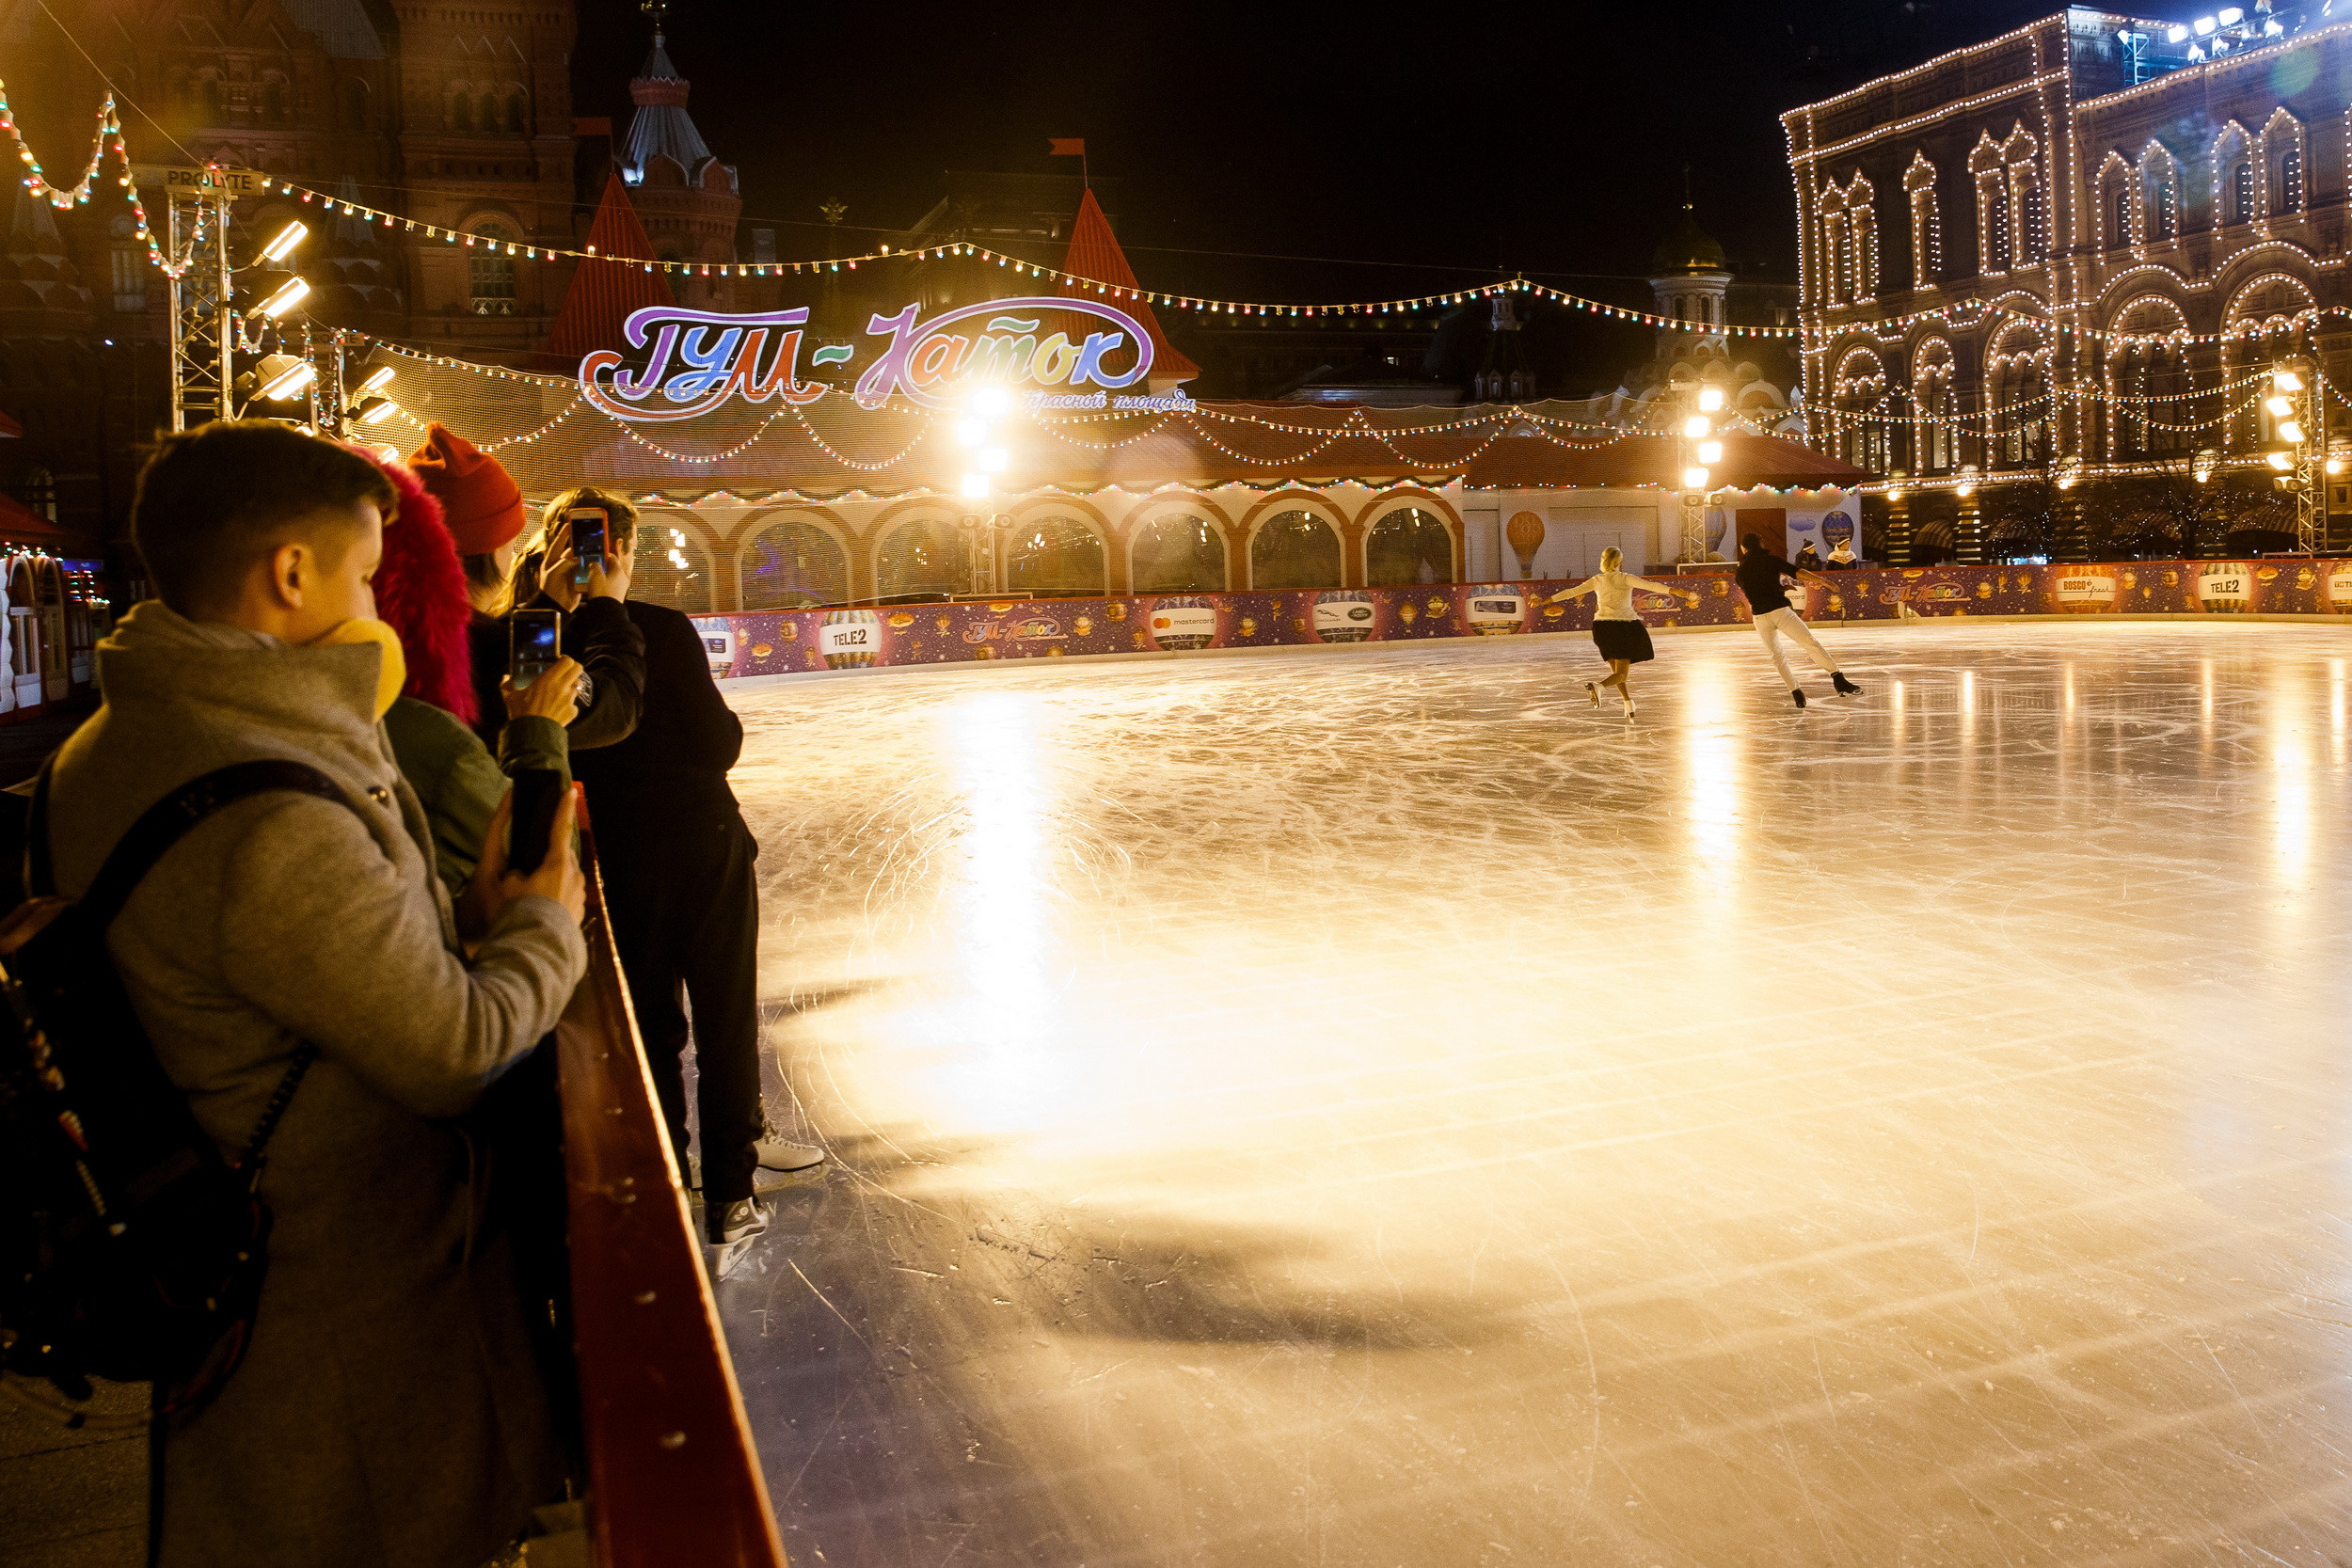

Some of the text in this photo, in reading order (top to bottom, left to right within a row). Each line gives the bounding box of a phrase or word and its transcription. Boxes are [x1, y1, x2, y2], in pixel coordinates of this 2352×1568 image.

[2063, 580, 2087, 591] BOSCO
[2210, 578, 2239, 594] TELE2
[834, 628, 867, 645] TELE2
